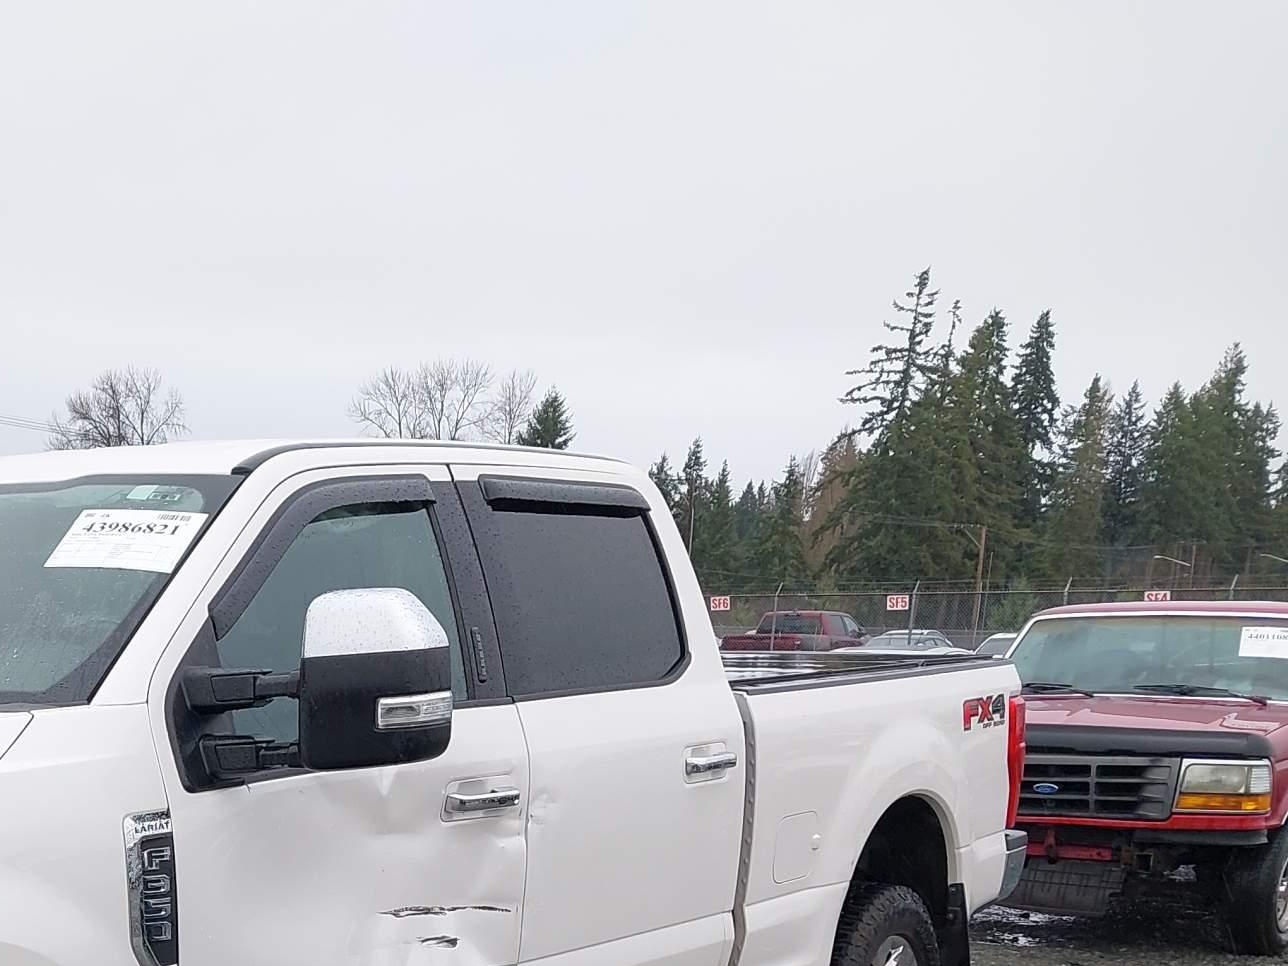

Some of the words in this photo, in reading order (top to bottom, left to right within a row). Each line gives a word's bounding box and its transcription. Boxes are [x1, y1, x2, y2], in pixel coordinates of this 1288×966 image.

[81, 521, 181, 536] 43986821
[712, 598, 729, 609] SF6
[888, 597, 908, 609] SF5
[963, 693, 1005, 731] FX4
[134, 819, 170, 834] LARIAT
